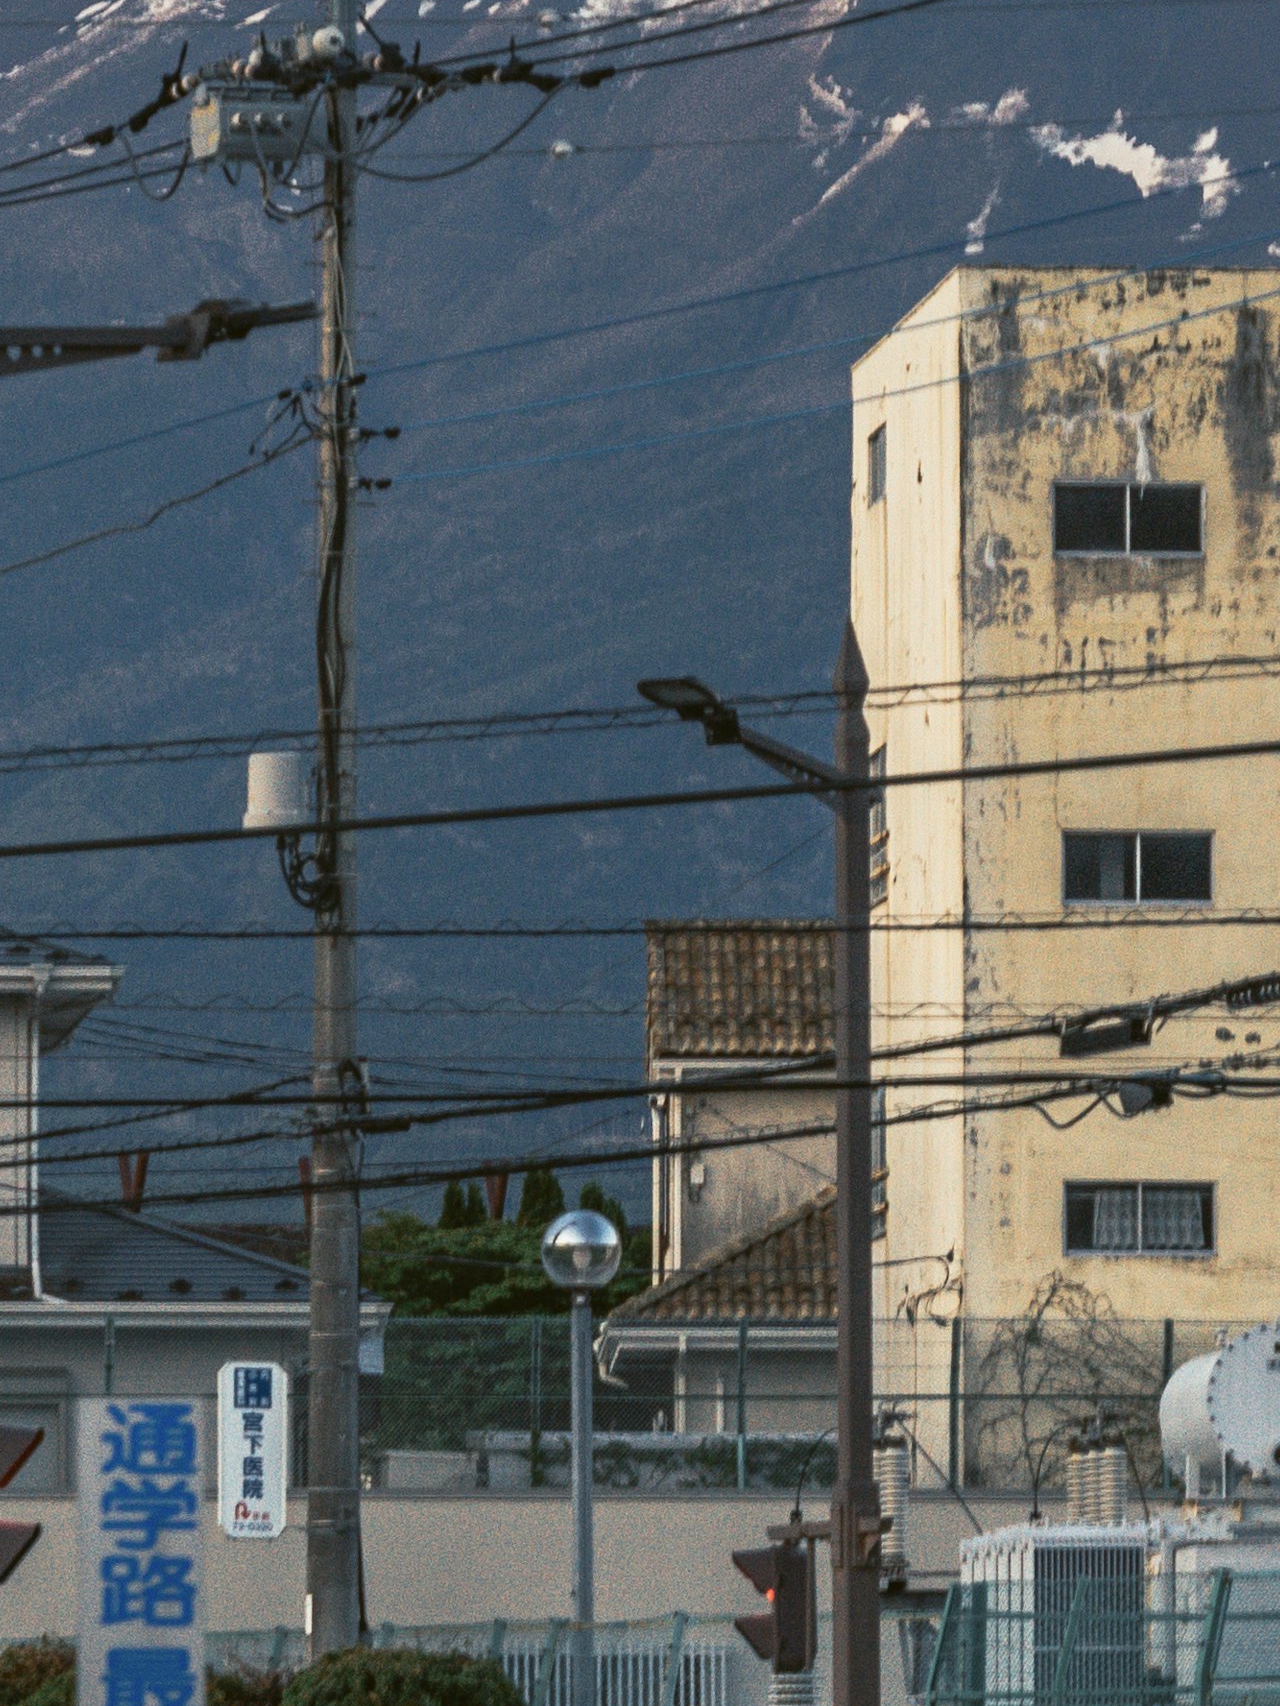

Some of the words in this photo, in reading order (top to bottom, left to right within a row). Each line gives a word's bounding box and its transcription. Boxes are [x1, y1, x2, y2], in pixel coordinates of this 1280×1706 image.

[100, 1403, 198, 1629] 通学路
[242, 1412, 266, 1500] 宮下医院
